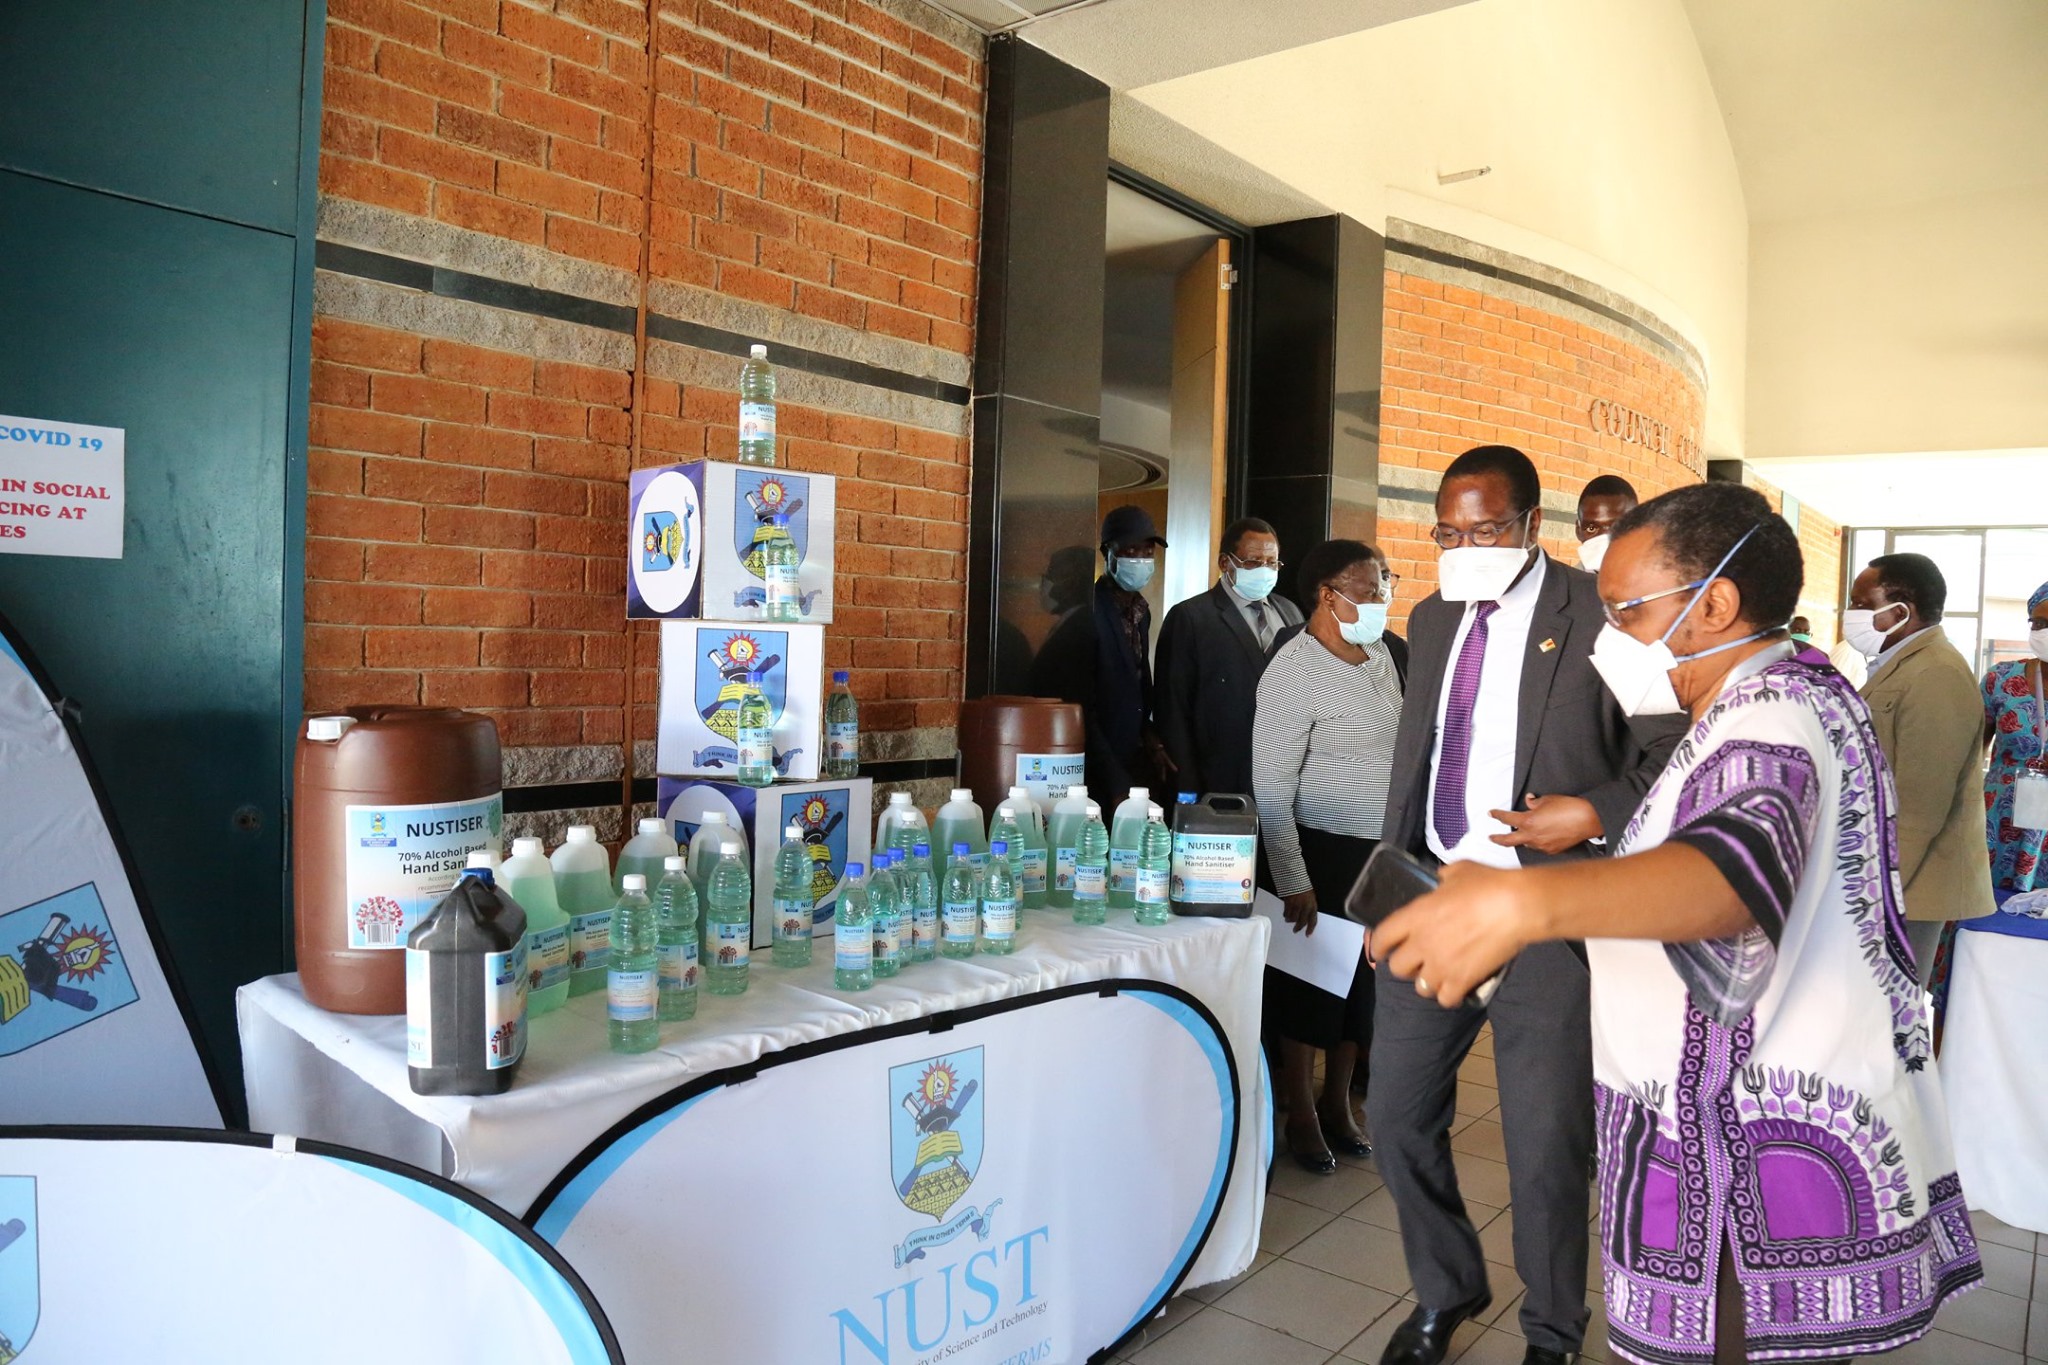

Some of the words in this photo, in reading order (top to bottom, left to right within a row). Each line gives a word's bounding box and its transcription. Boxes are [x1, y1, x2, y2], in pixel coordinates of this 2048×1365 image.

[0, 425, 71, 446] COVID
[79, 437, 103, 451] 19
[0, 479, 26, 493] IN
[33, 481, 111, 500] SOCIAL
[57, 506, 87, 520] AT
[1048, 791, 1068, 799] Hand
[406, 815, 483, 838] NUSTISER
[397, 852, 422, 862] 70%
[424, 846, 463, 860] Alcohol
[464, 842, 487, 854] Based
[1188, 842, 1232, 850] NUSTISER
[403, 861, 439, 874] Hand
[443, 857, 468, 870] Sani
[909, 1233, 927, 1247] THINK
[928, 1233, 935, 1241] IN
[935, 1227, 955, 1240] OTHER
[955, 1210, 975, 1230] TERMS
[829, 1225, 1049, 1365] NUST
[932, 1350, 947, 1362] of
[945, 1333, 980, 1357] Science
[982, 1322, 998, 1339] and
[1000, 1300, 1049, 1330] Technology
